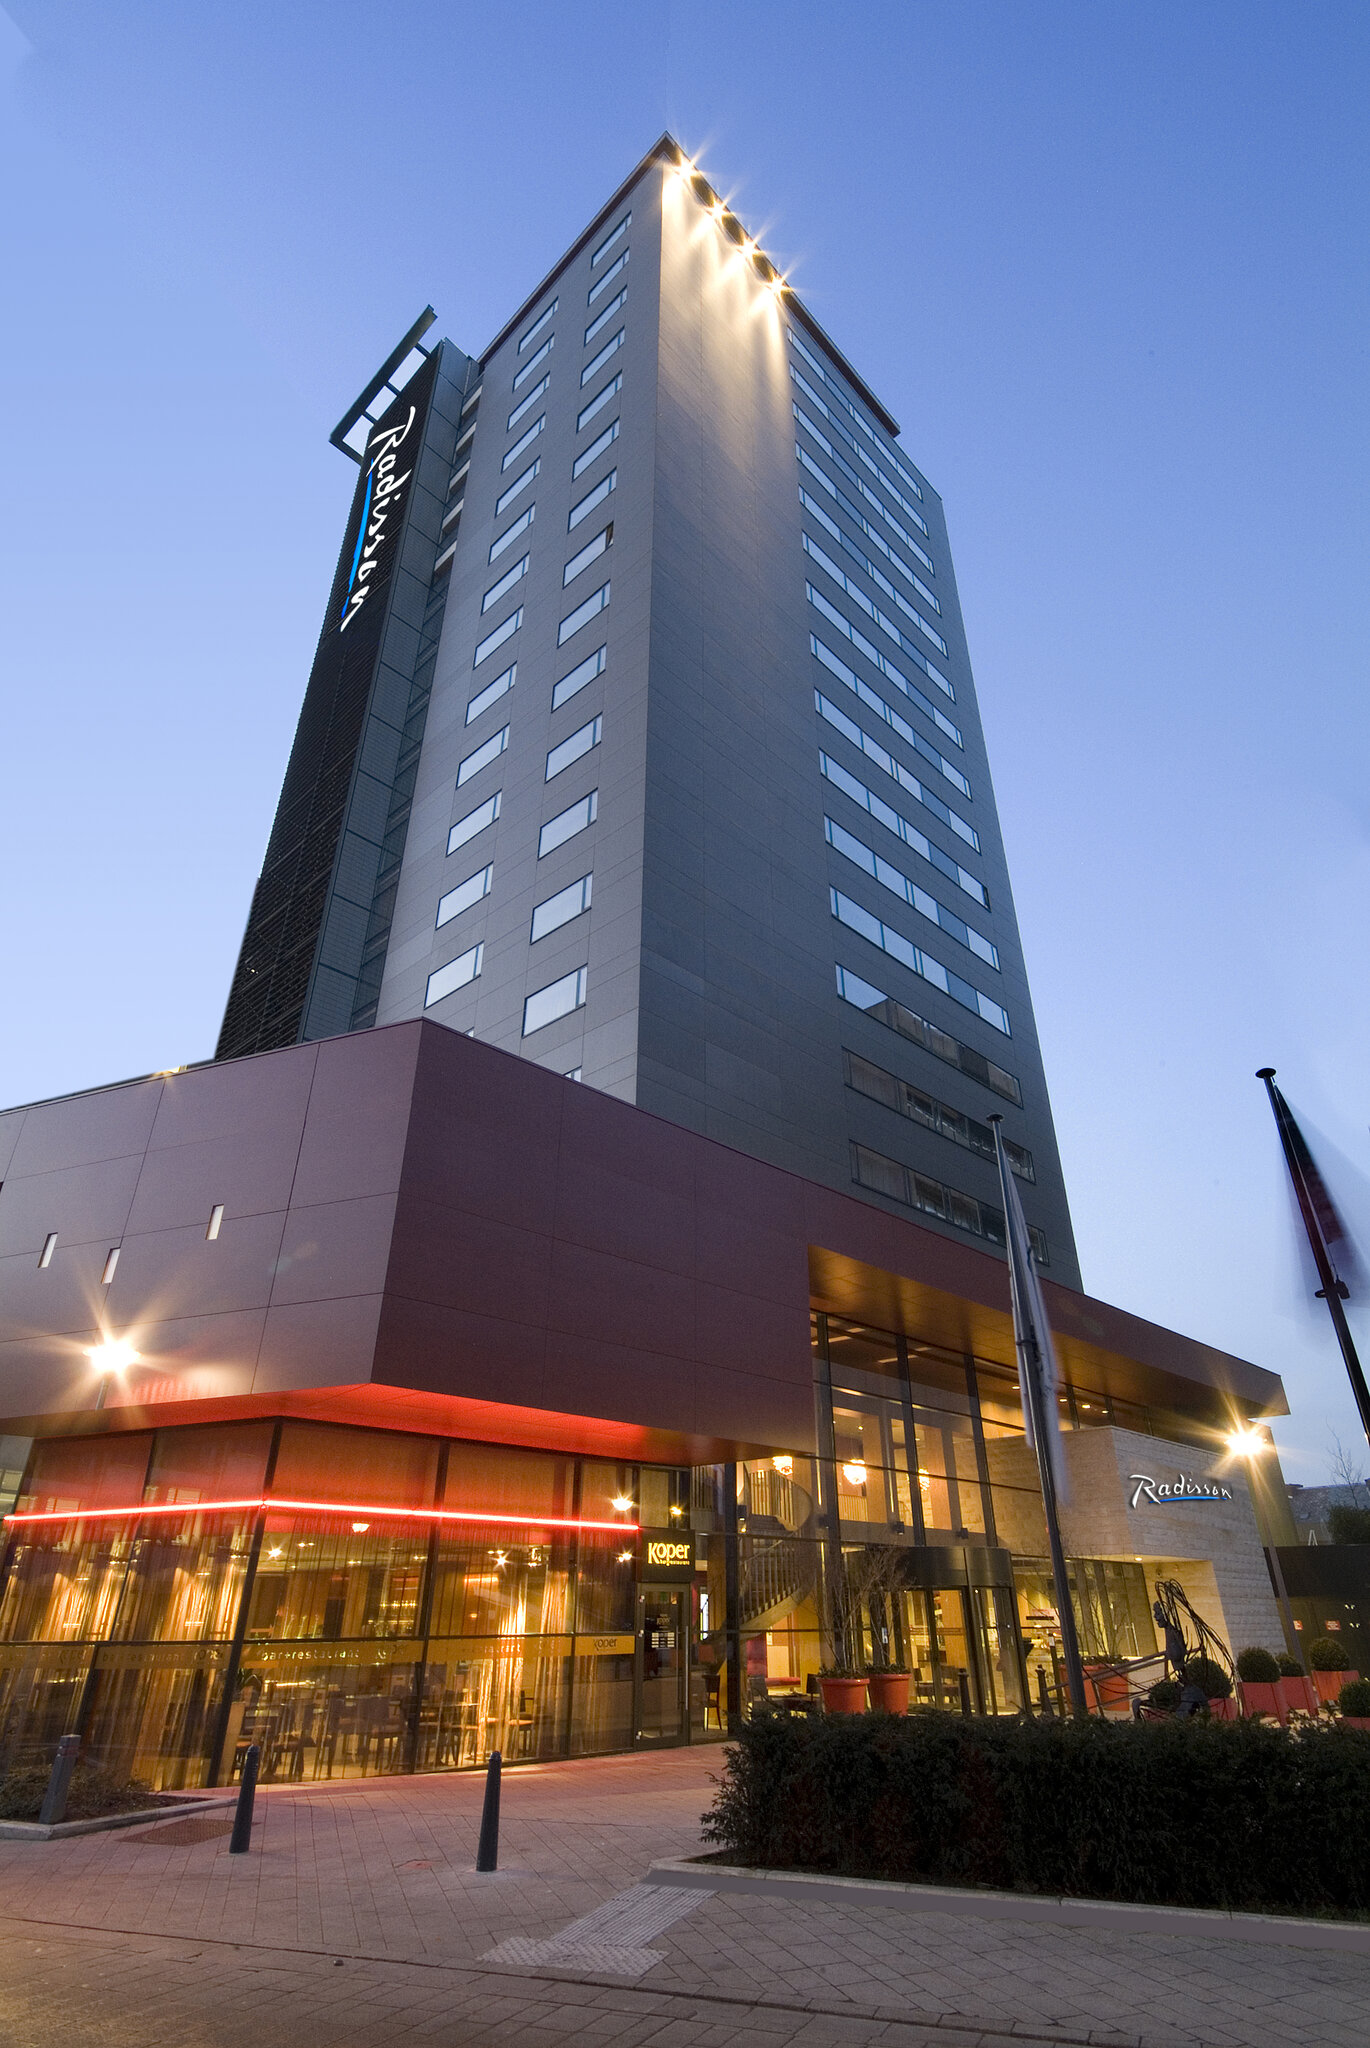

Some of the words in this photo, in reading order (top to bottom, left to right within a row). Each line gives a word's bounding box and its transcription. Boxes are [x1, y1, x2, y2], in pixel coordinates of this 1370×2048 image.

[340, 405, 416, 632] Radisson
[1129, 1473, 1232, 1509] Radisson
[647, 1542, 690, 1567] Koper
